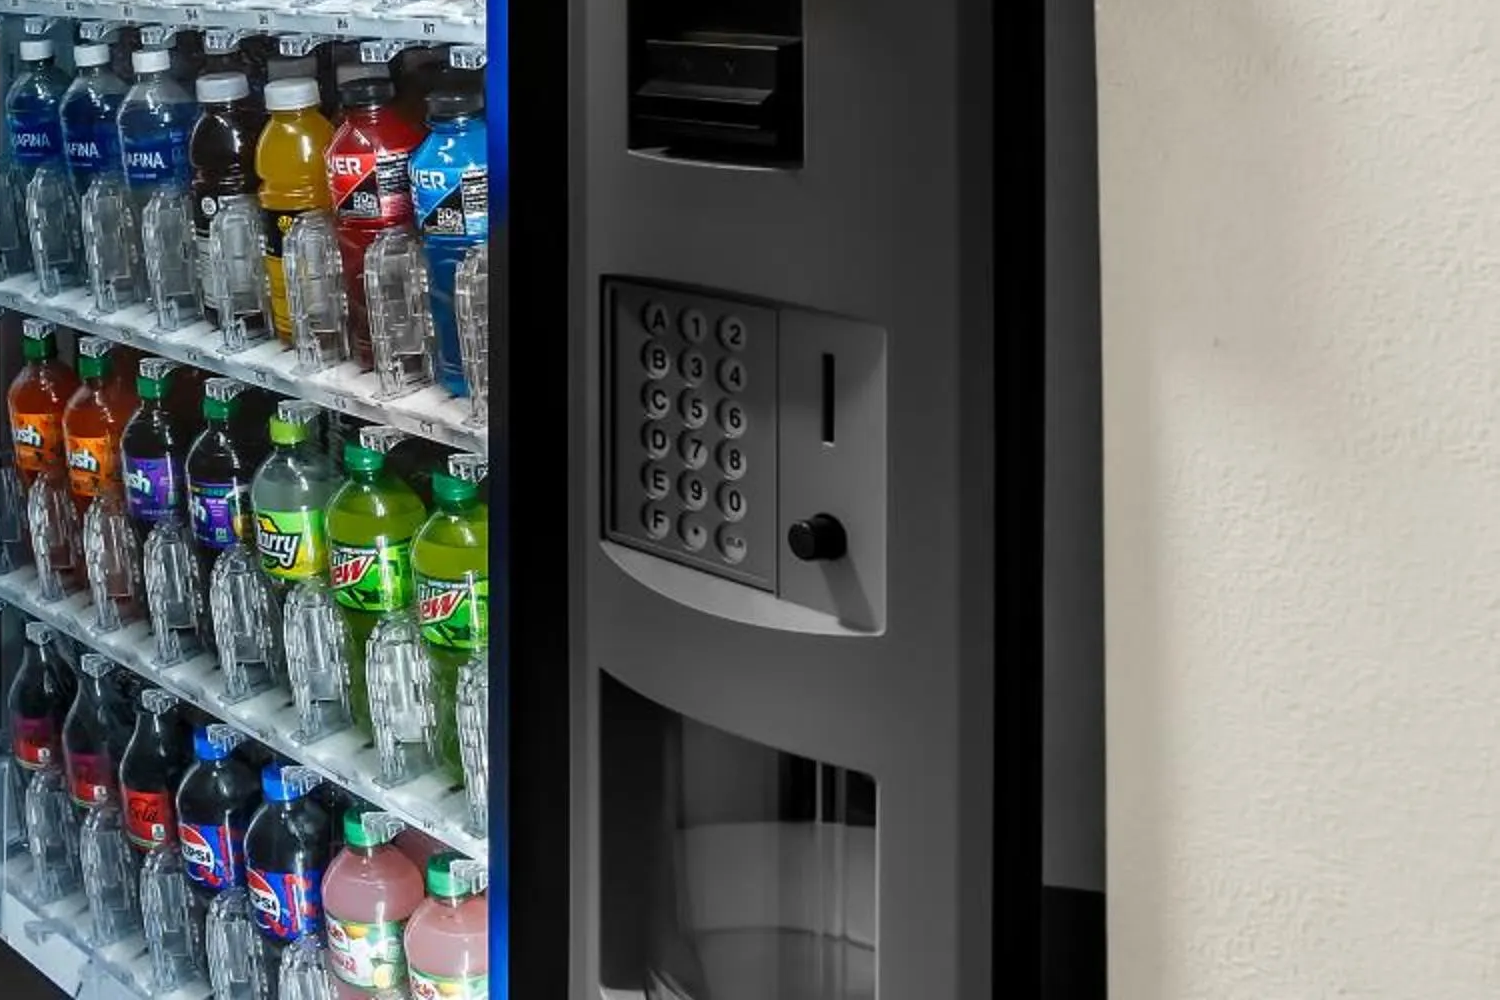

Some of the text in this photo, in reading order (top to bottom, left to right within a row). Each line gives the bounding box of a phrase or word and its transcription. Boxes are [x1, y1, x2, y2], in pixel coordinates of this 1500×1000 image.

[653, 309, 667, 330] A
[692, 317, 700, 337] 1
[731, 324, 741, 345] 2
[653, 349, 666, 370] B
[691, 357, 702, 378] 3
[730, 365, 741, 386] 4
[653, 389, 666, 411] C
[691, 398, 703, 419] 5
[730, 407, 740, 429] 6
[653, 430, 666, 450] D
[691, 439, 702, 459] 7
[730, 449, 741, 470] 8
[653, 470, 666, 491] E
[691, 480, 702, 501] 9
[729, 490, 740, 512] 0
[653, 510, 665, 530] F
[257, 531, 299, 568] arry
